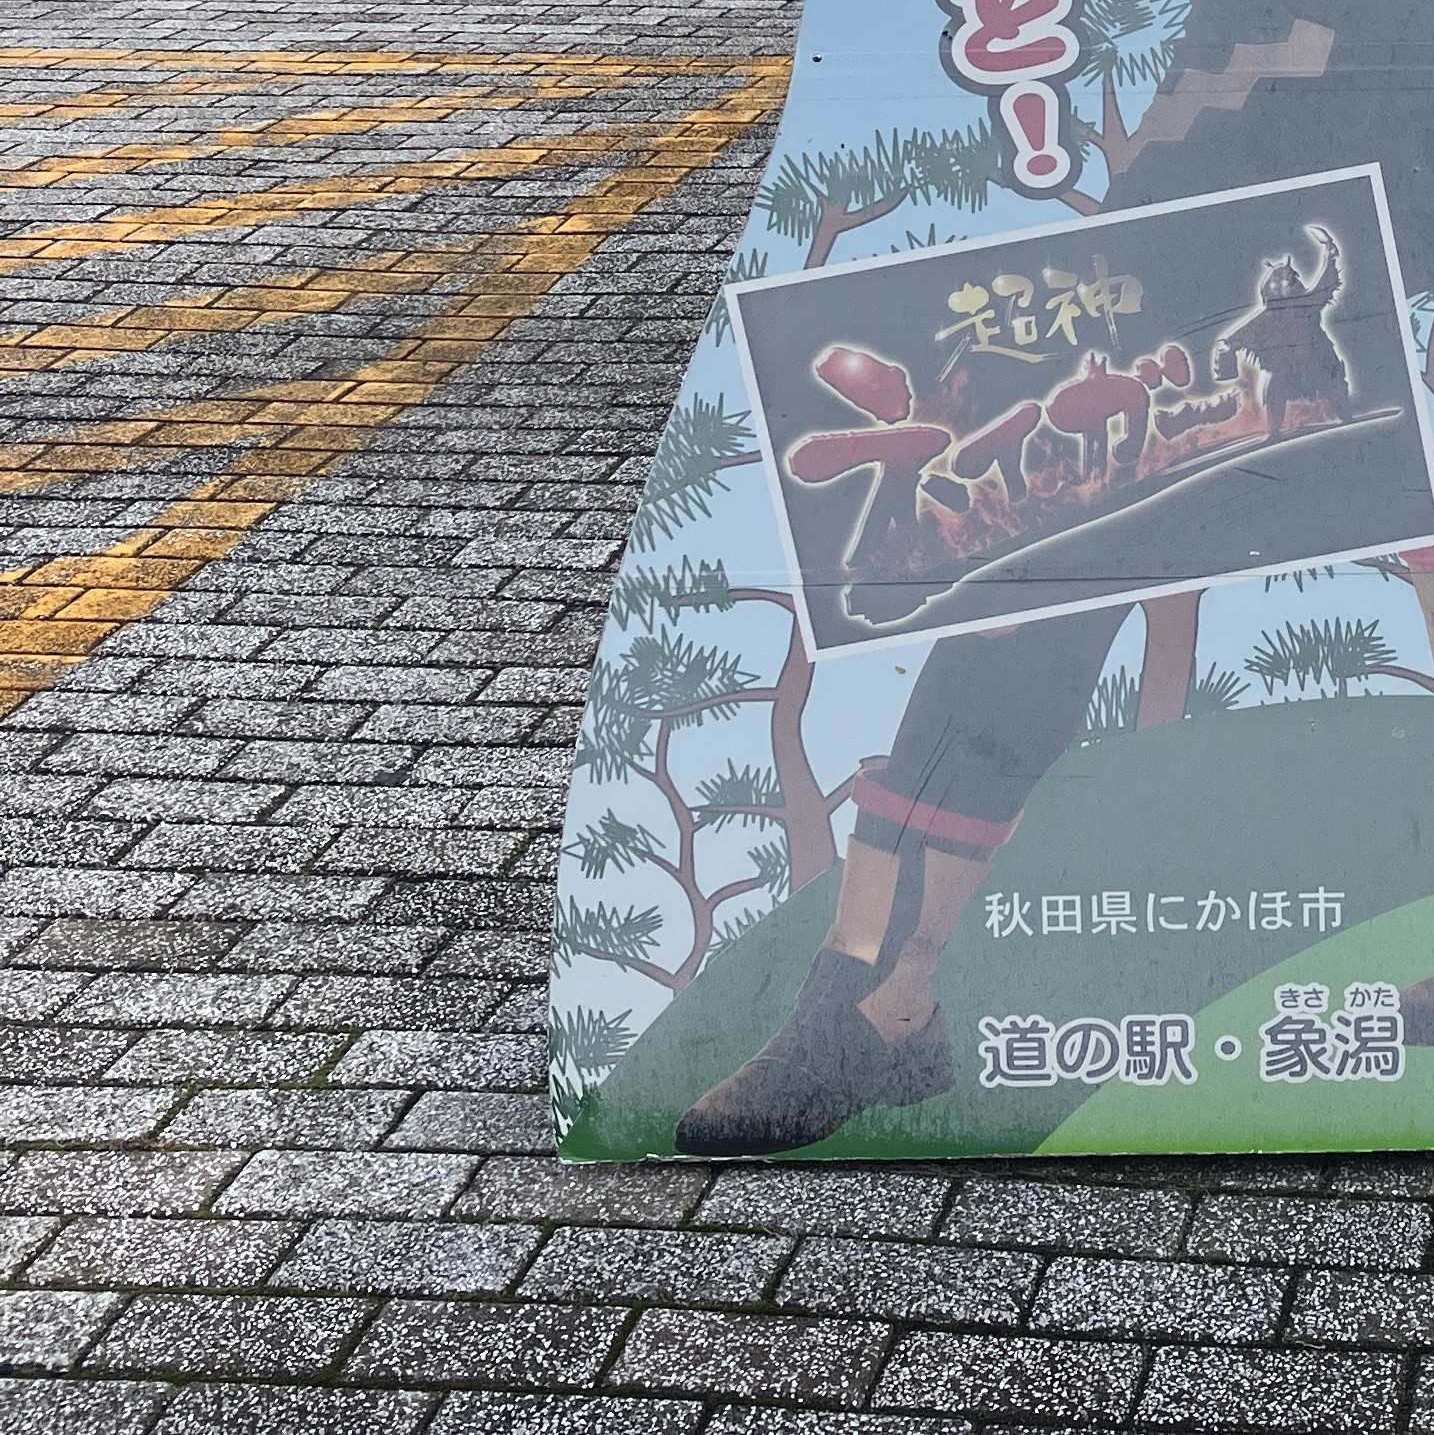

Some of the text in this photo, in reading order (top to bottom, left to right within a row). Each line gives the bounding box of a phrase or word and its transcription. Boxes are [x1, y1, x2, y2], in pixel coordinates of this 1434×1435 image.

[935, 254, 1145, 383] 超神
[984, 886, 1345, 938] 秋田県にかほ市
[1279, 986, 1395, 1009] きさ かた
